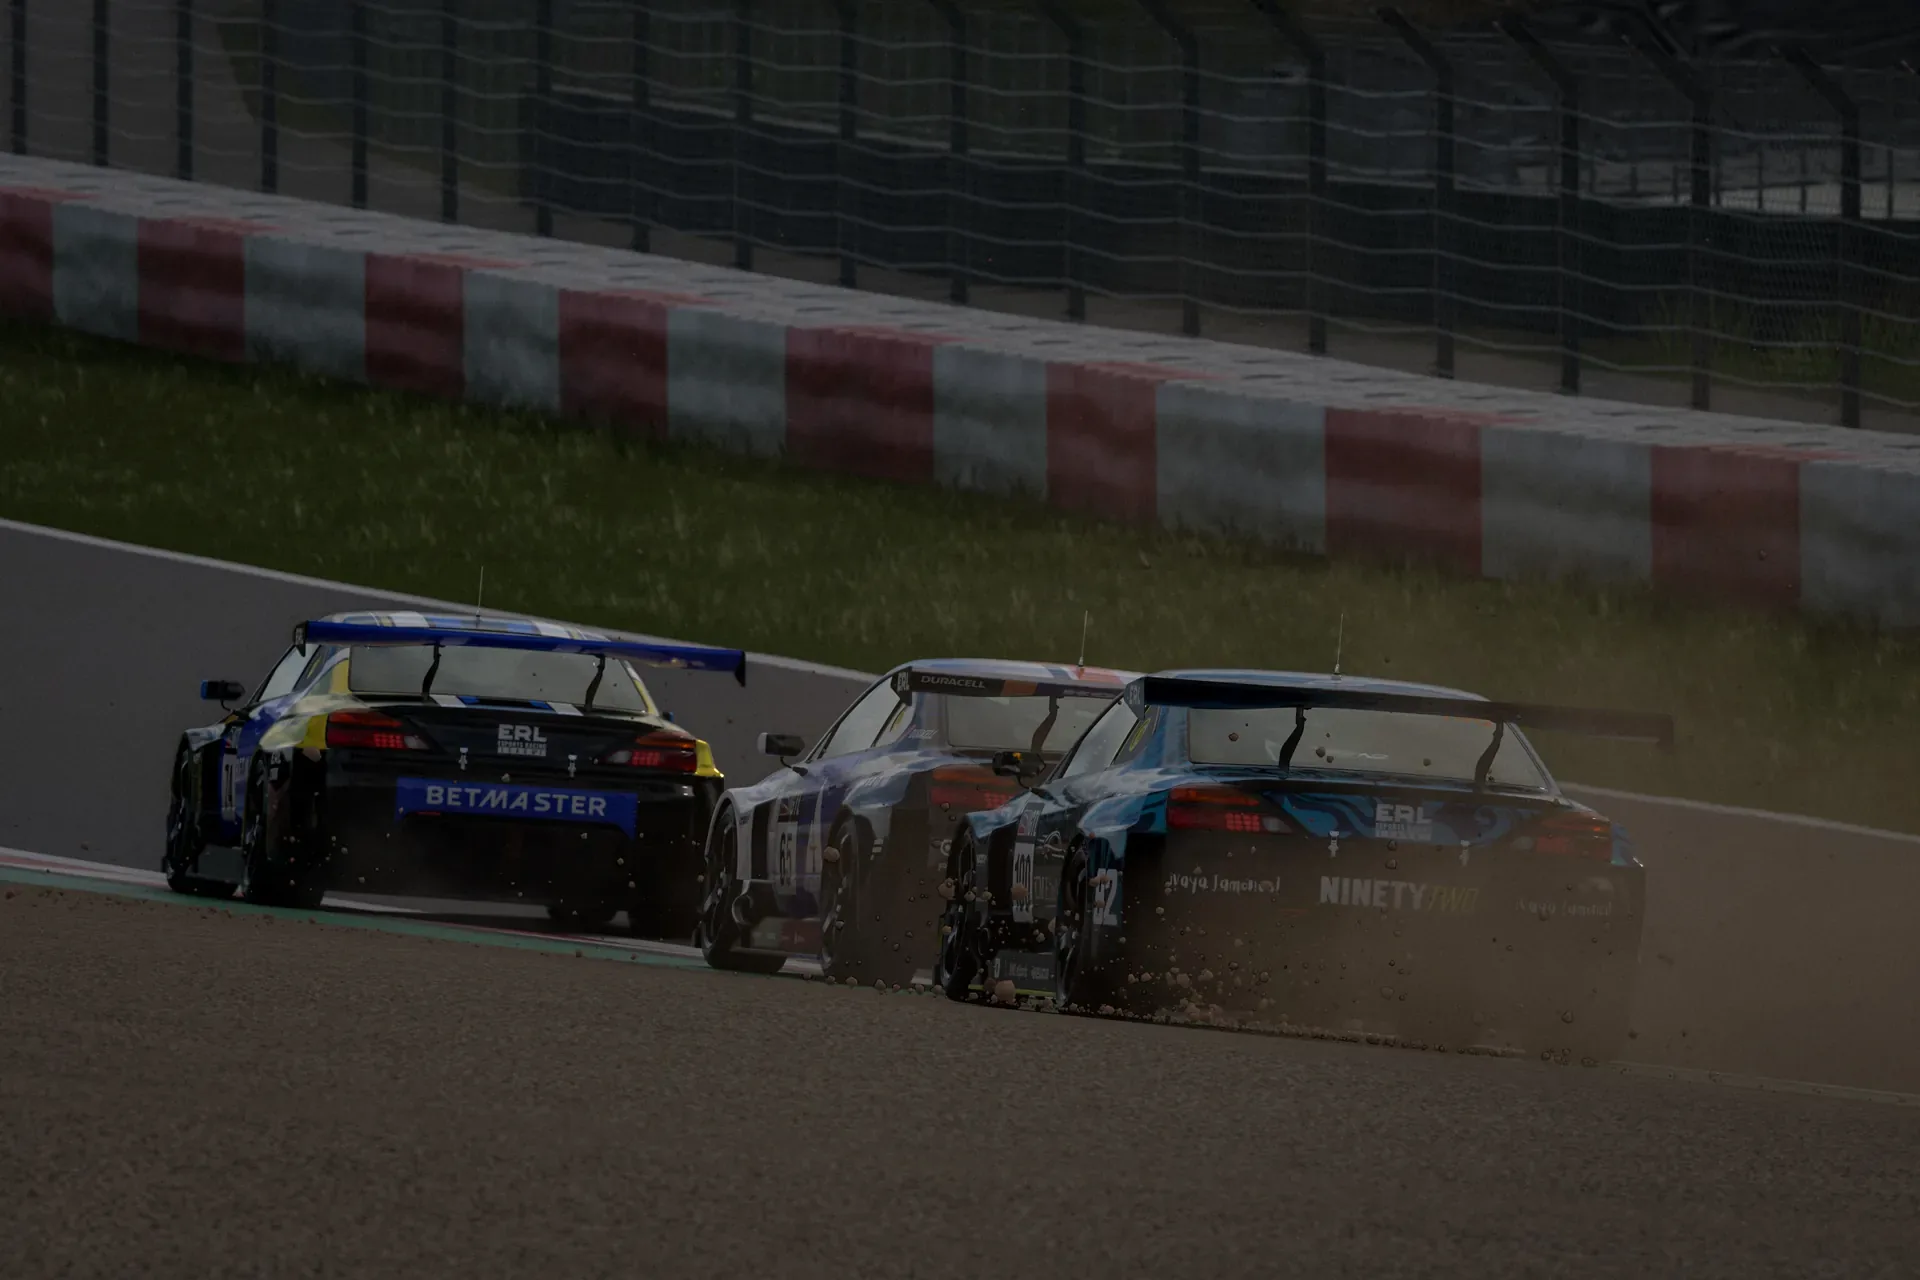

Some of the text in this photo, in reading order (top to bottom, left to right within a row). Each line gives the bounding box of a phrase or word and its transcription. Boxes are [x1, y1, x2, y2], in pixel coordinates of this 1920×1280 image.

[920, 675, 986, 689] DURACELL
[498, 723, 548, 743] ERL
[425, 785, 608, 817] BETMASTER
[1376, 803, 1433, 825] ERL
[779, 831, 793, 887] 65
